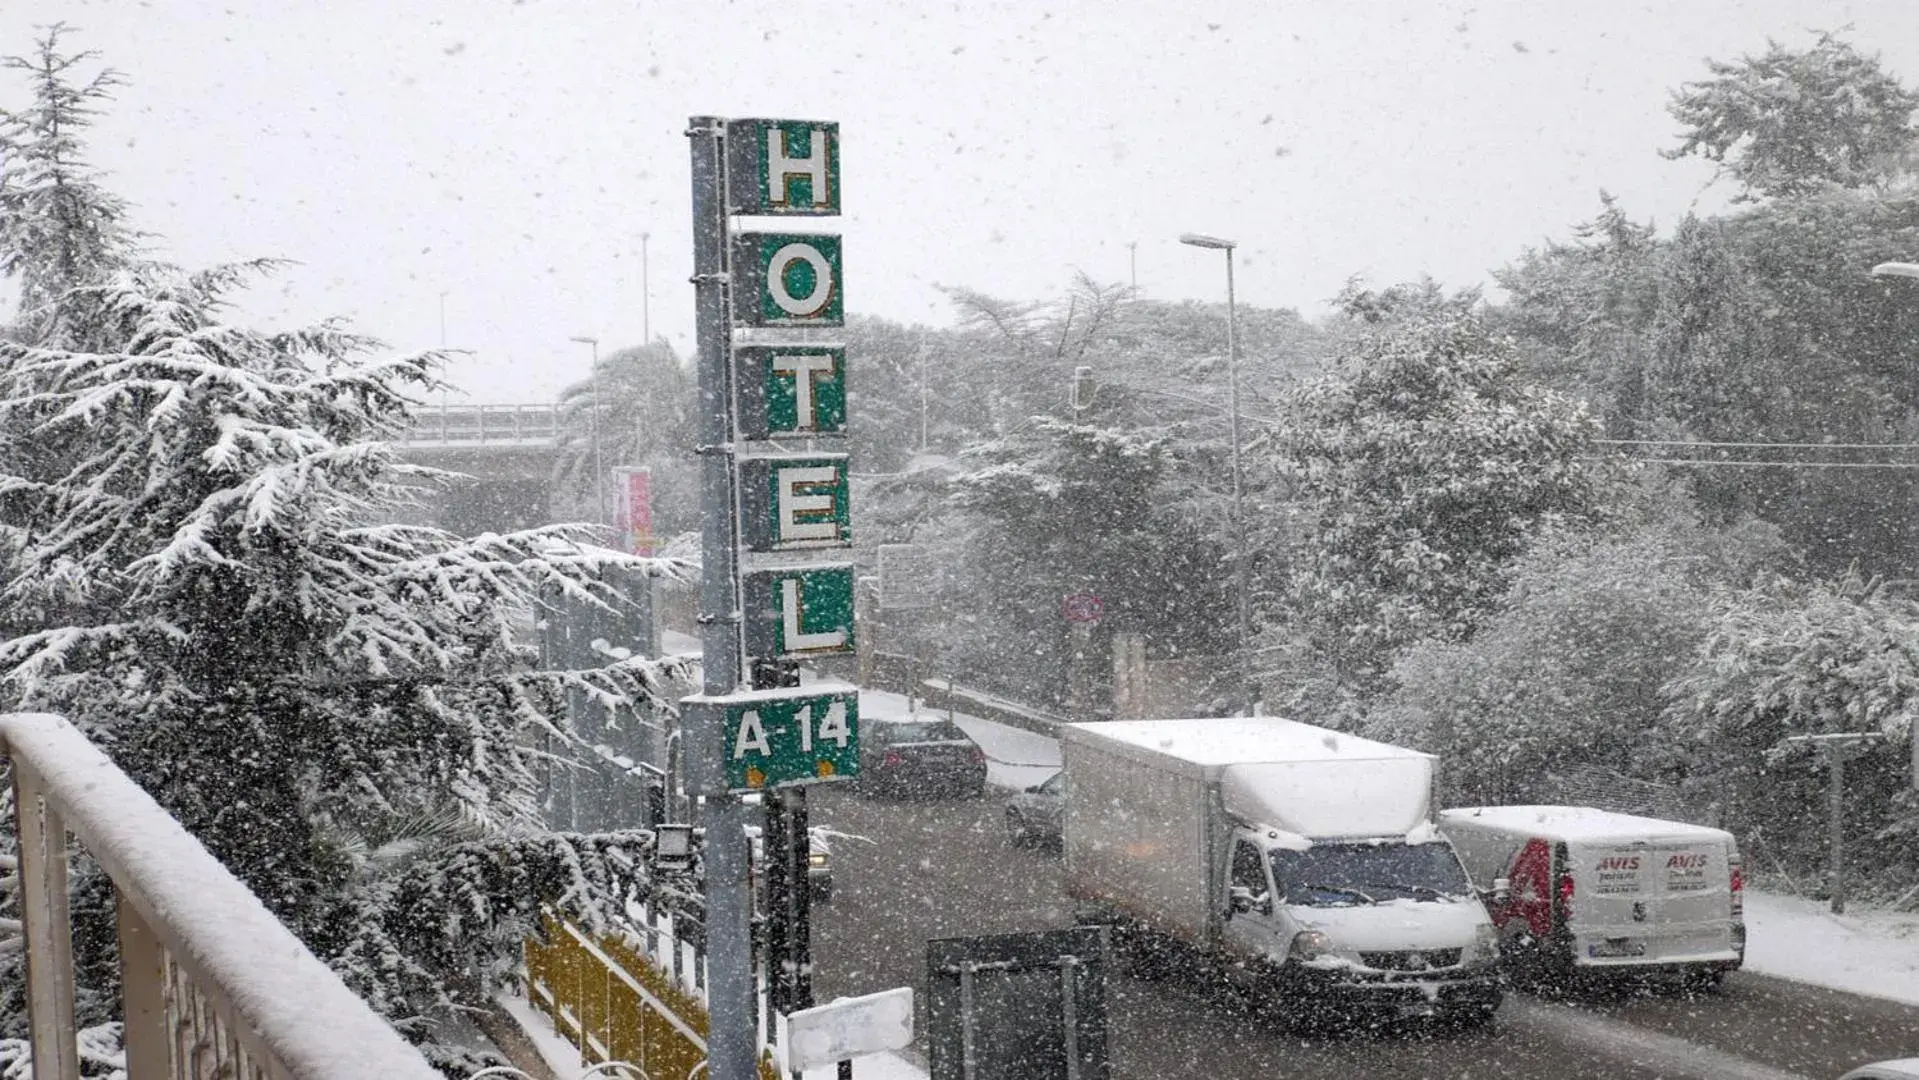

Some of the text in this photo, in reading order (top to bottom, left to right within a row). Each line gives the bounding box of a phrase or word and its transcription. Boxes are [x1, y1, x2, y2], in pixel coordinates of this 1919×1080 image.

[766, 128, 846, 653] HOTEL
[733, 701, 851, 760] A-14
[1595, 856, 1641, 871] AVIS
[1665, 854, 1708, 869] AVIS
